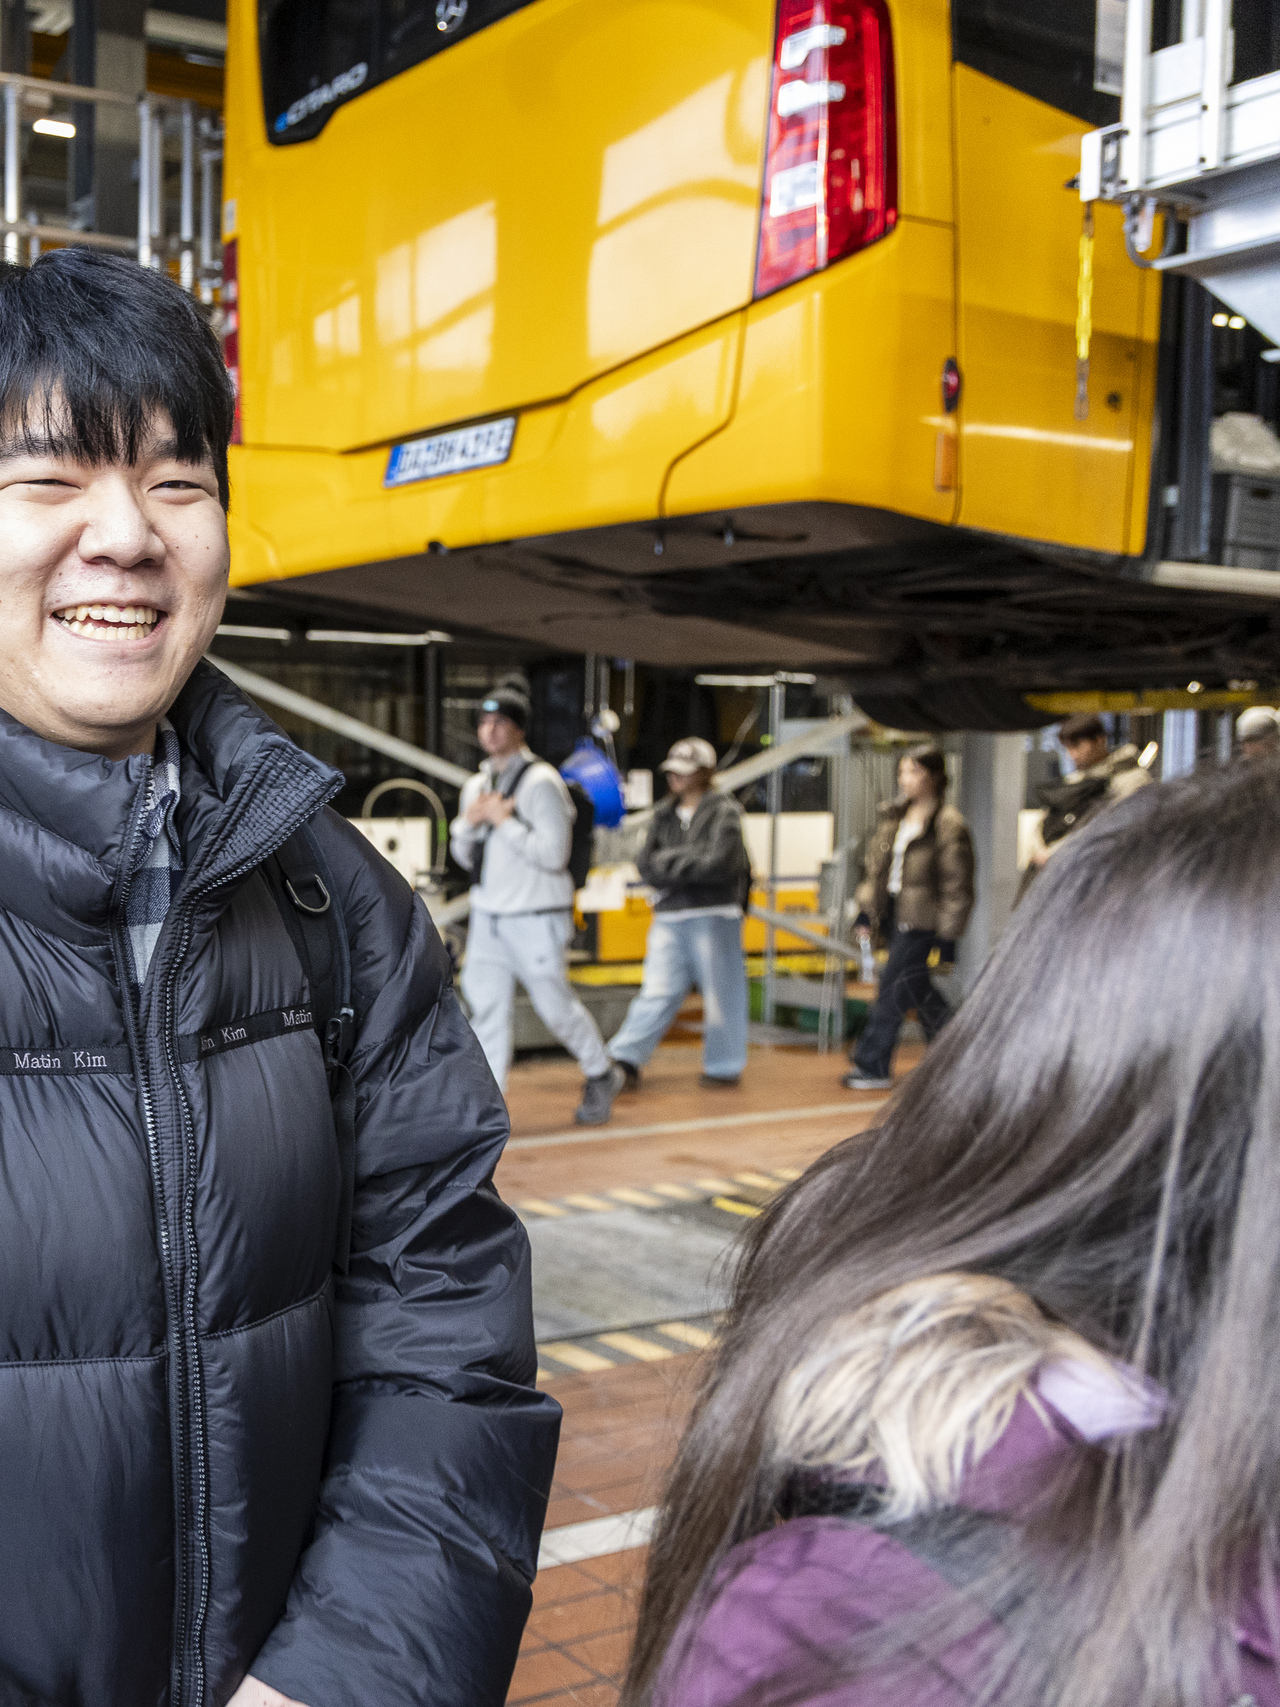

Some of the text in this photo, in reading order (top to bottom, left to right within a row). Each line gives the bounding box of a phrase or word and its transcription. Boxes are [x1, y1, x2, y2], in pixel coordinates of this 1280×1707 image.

[281, 1009, 314, 1028] Matin
[220, 1026, 248, 1044] Kim
[13, 1051, 108, 1069] Matin Kim
